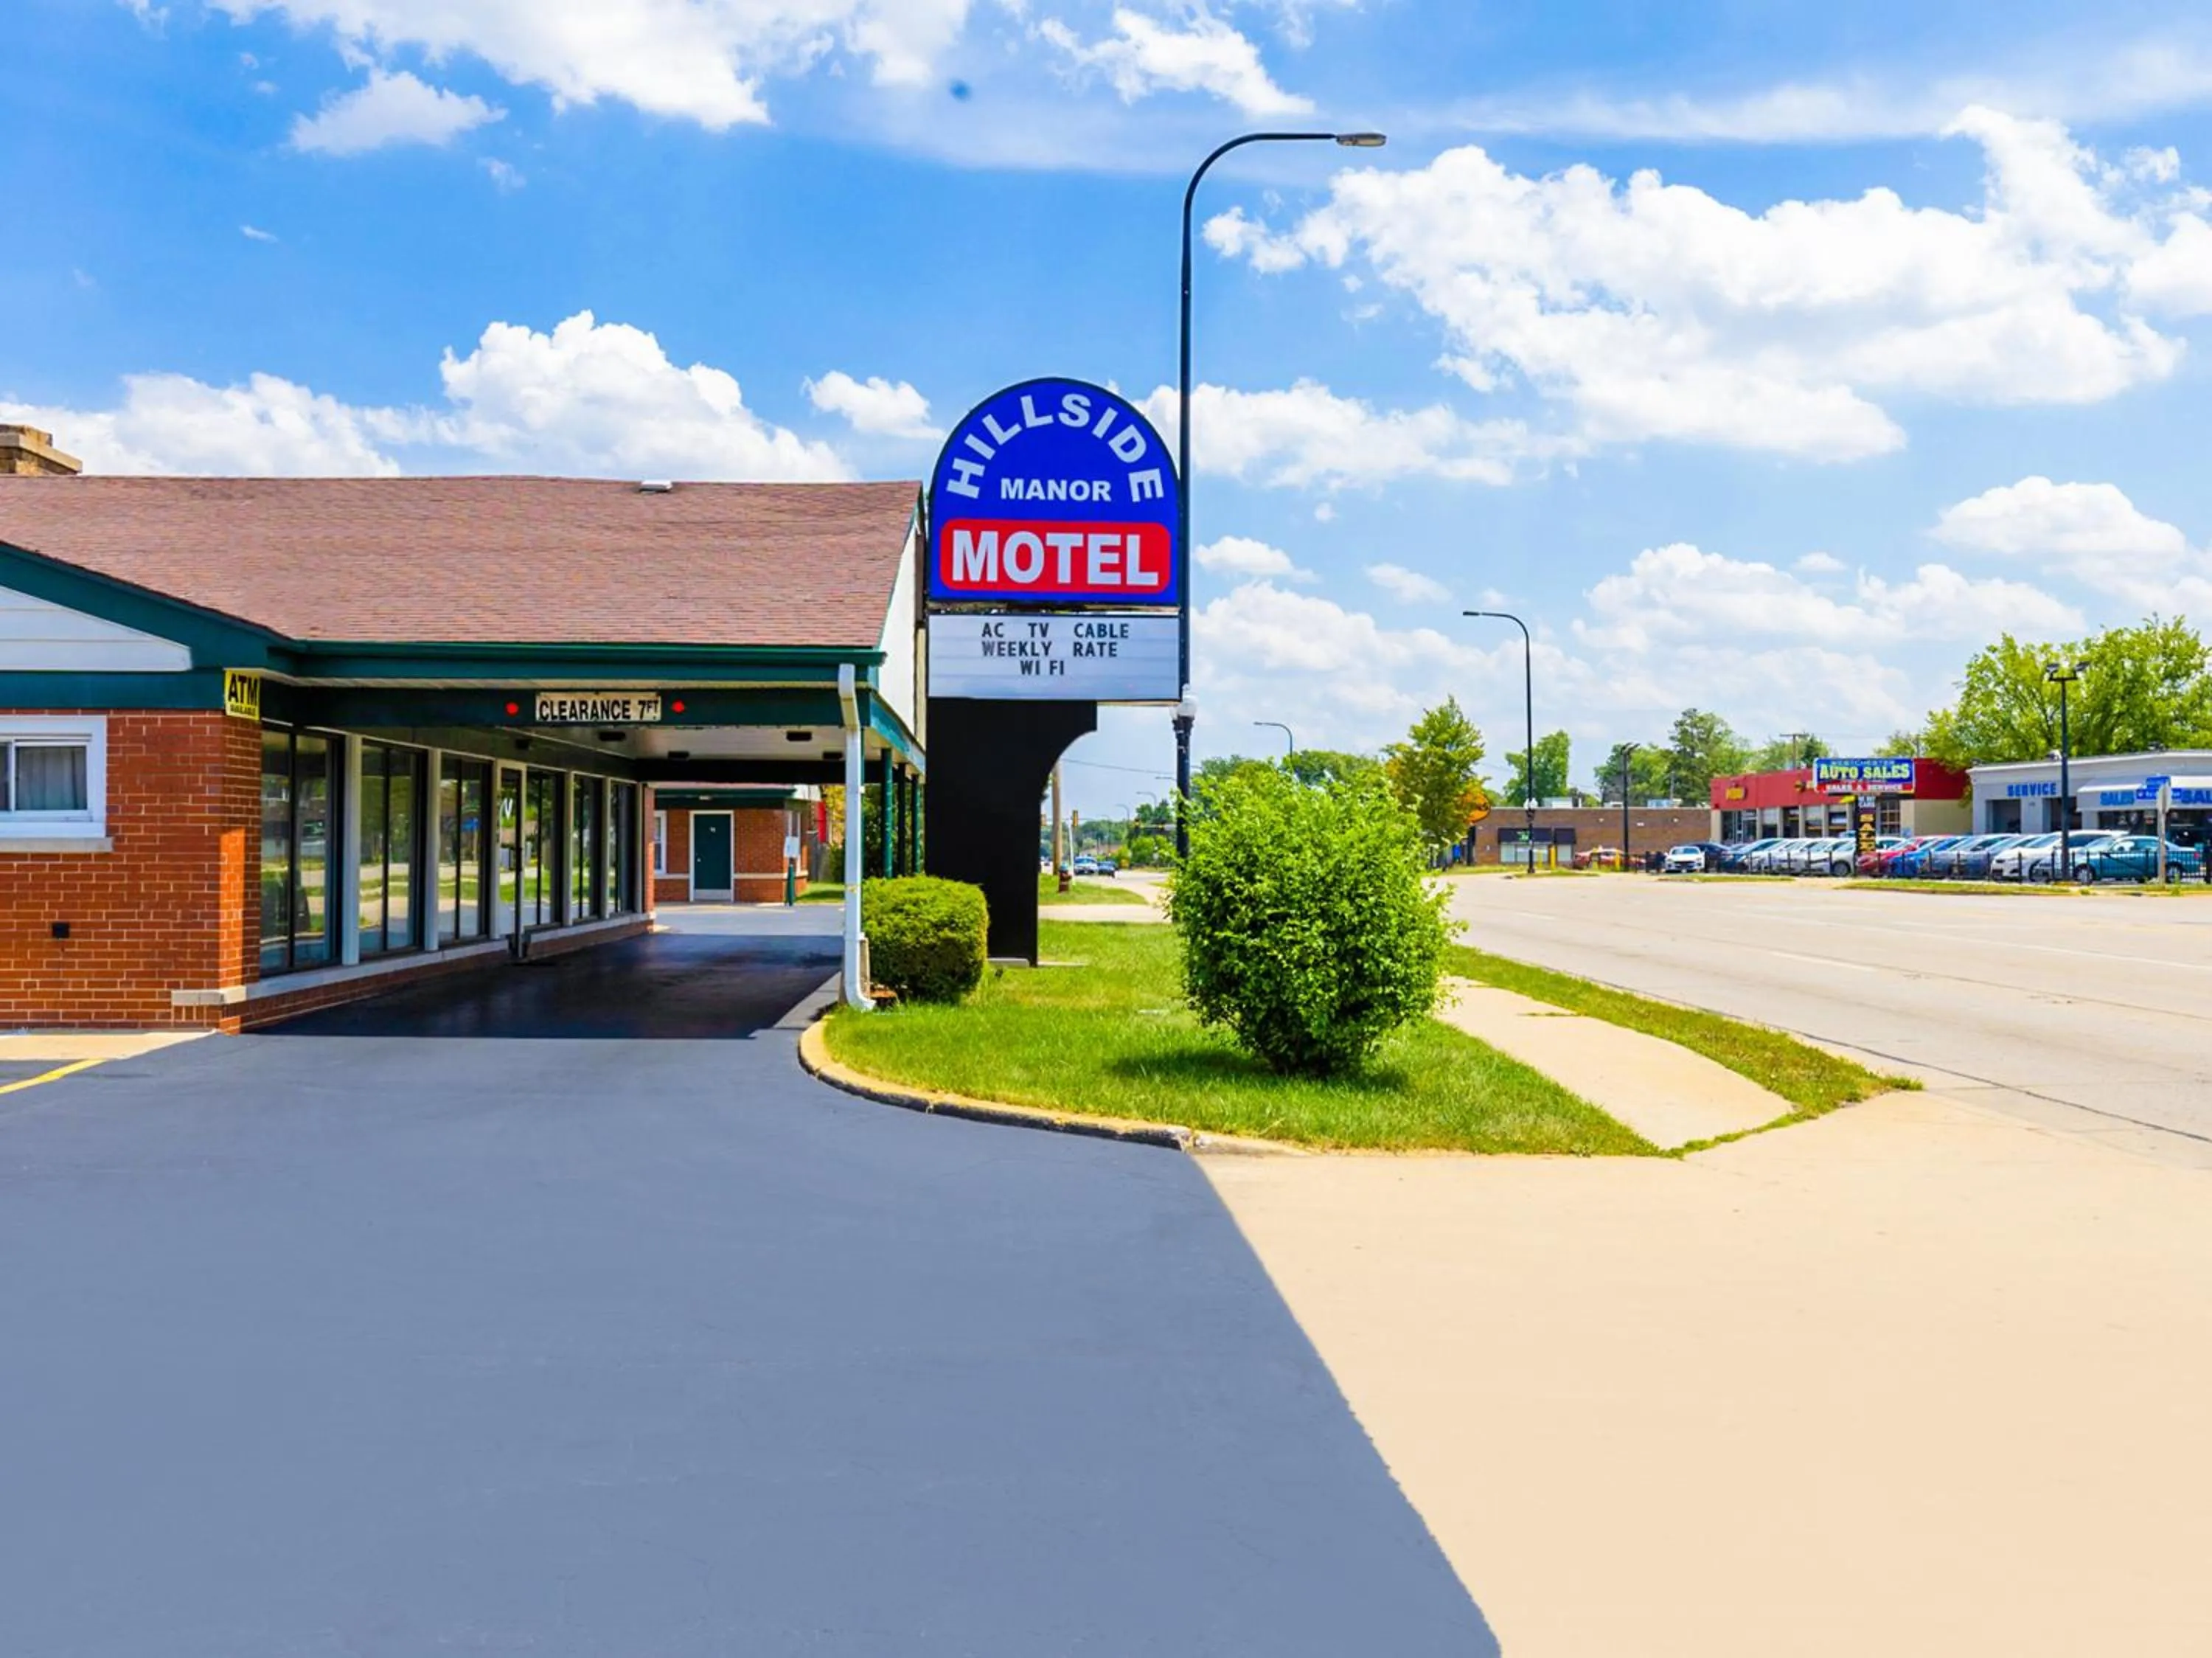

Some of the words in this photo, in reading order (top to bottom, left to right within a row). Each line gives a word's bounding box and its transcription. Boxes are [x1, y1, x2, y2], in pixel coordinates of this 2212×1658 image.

[946, 393, 1164, 502] HILLSIDE
[1001, 478, 1111, 502] MANOR
[952, 530, 1158, 586] MOTEL
[981, 622, 1004, 638] AC
[1027, 622, 1049, 638] TV
[1074, 623, 1129, 638] CABLE
[981, 641, 1052, 657] WEEKLY
[1073, 642, 1118, 657] RATE
[229, 673, 257, 706] ATM
[540, 699, 631, 720] CLEARANCE
[1819, 764, 1858, 779] AUTO
[1863, 763, 1910, 779] SALES
[2007, 783, 2056, 797] SERVICE
